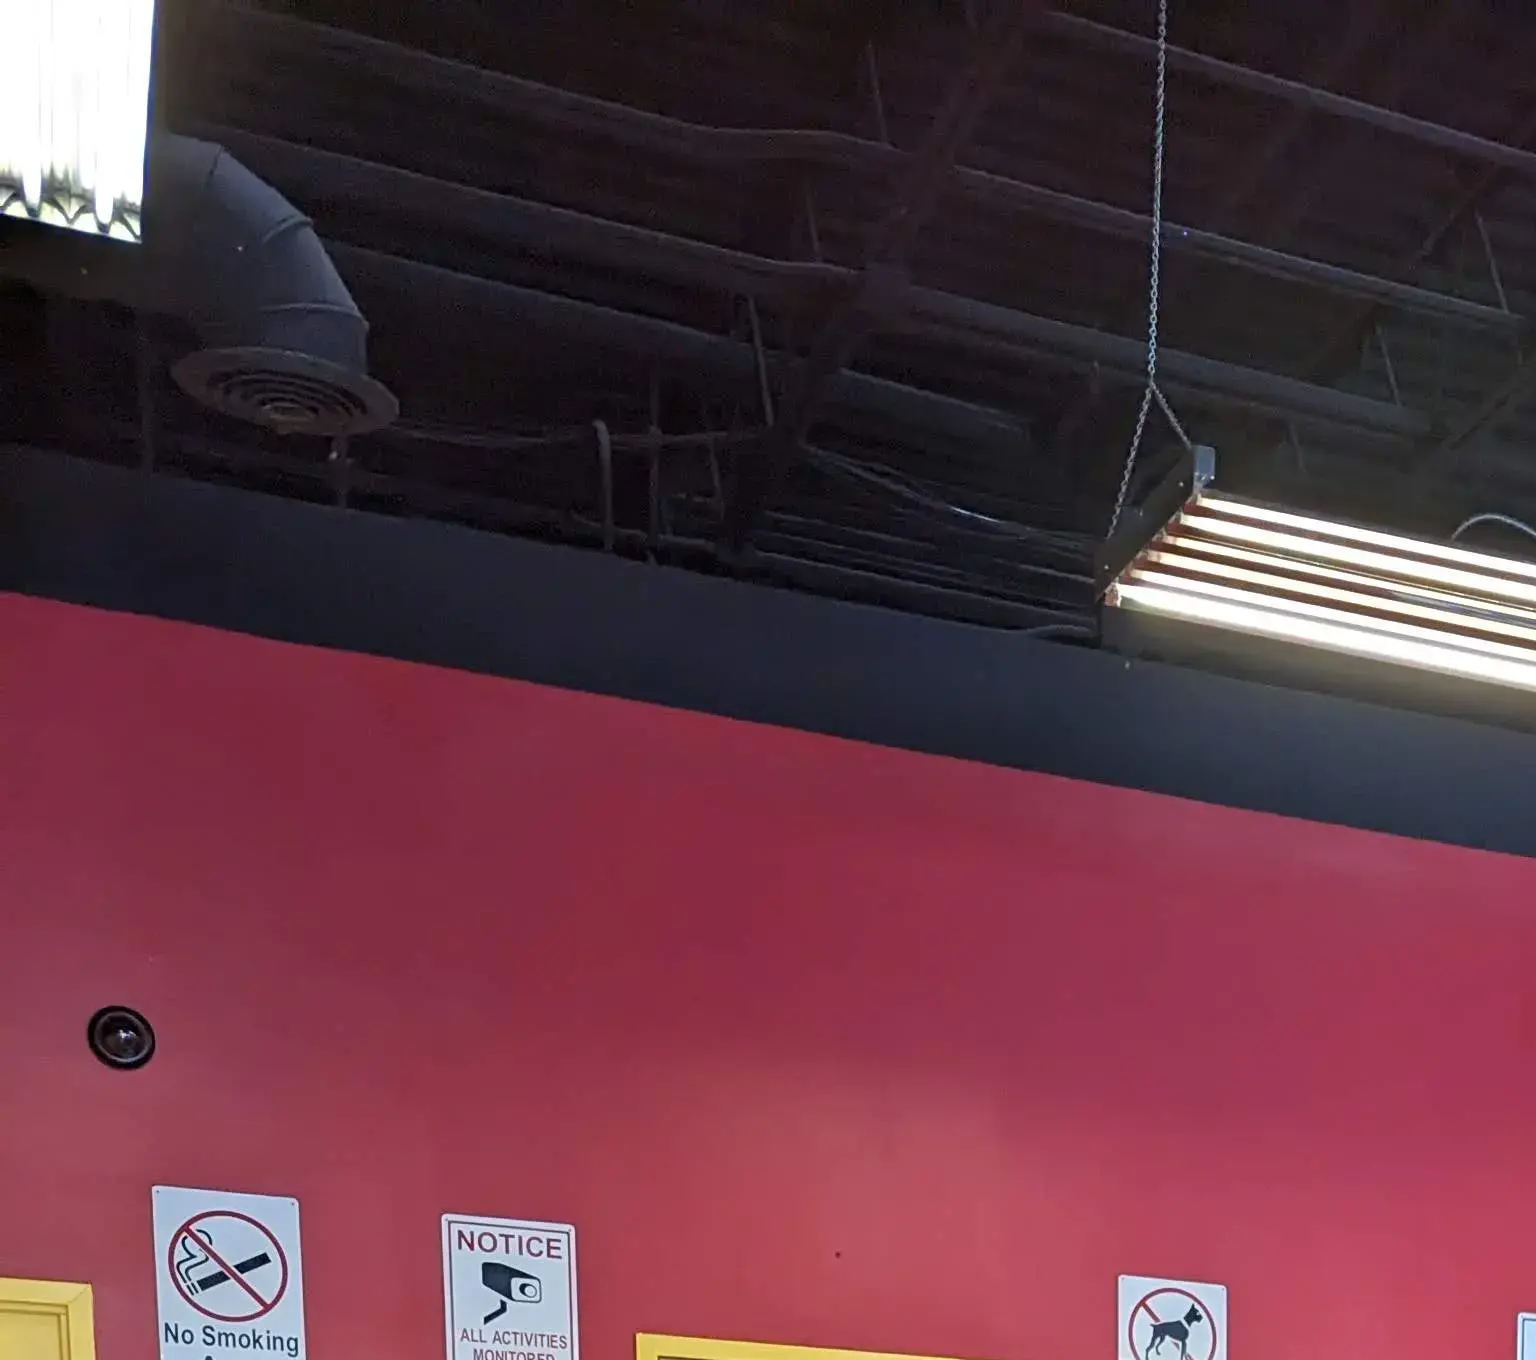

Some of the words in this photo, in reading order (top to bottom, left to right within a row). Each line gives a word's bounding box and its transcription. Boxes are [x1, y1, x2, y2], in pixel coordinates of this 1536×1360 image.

[457, 1230, 562, 1259] NOTICE
[164, 1322, 194, 1344] No
[202, 1325, 299, 1358] Smoking
[460, 1328, 487, 1343] ALL
[492, 1331, 568, 1349] ACTIVITIES
